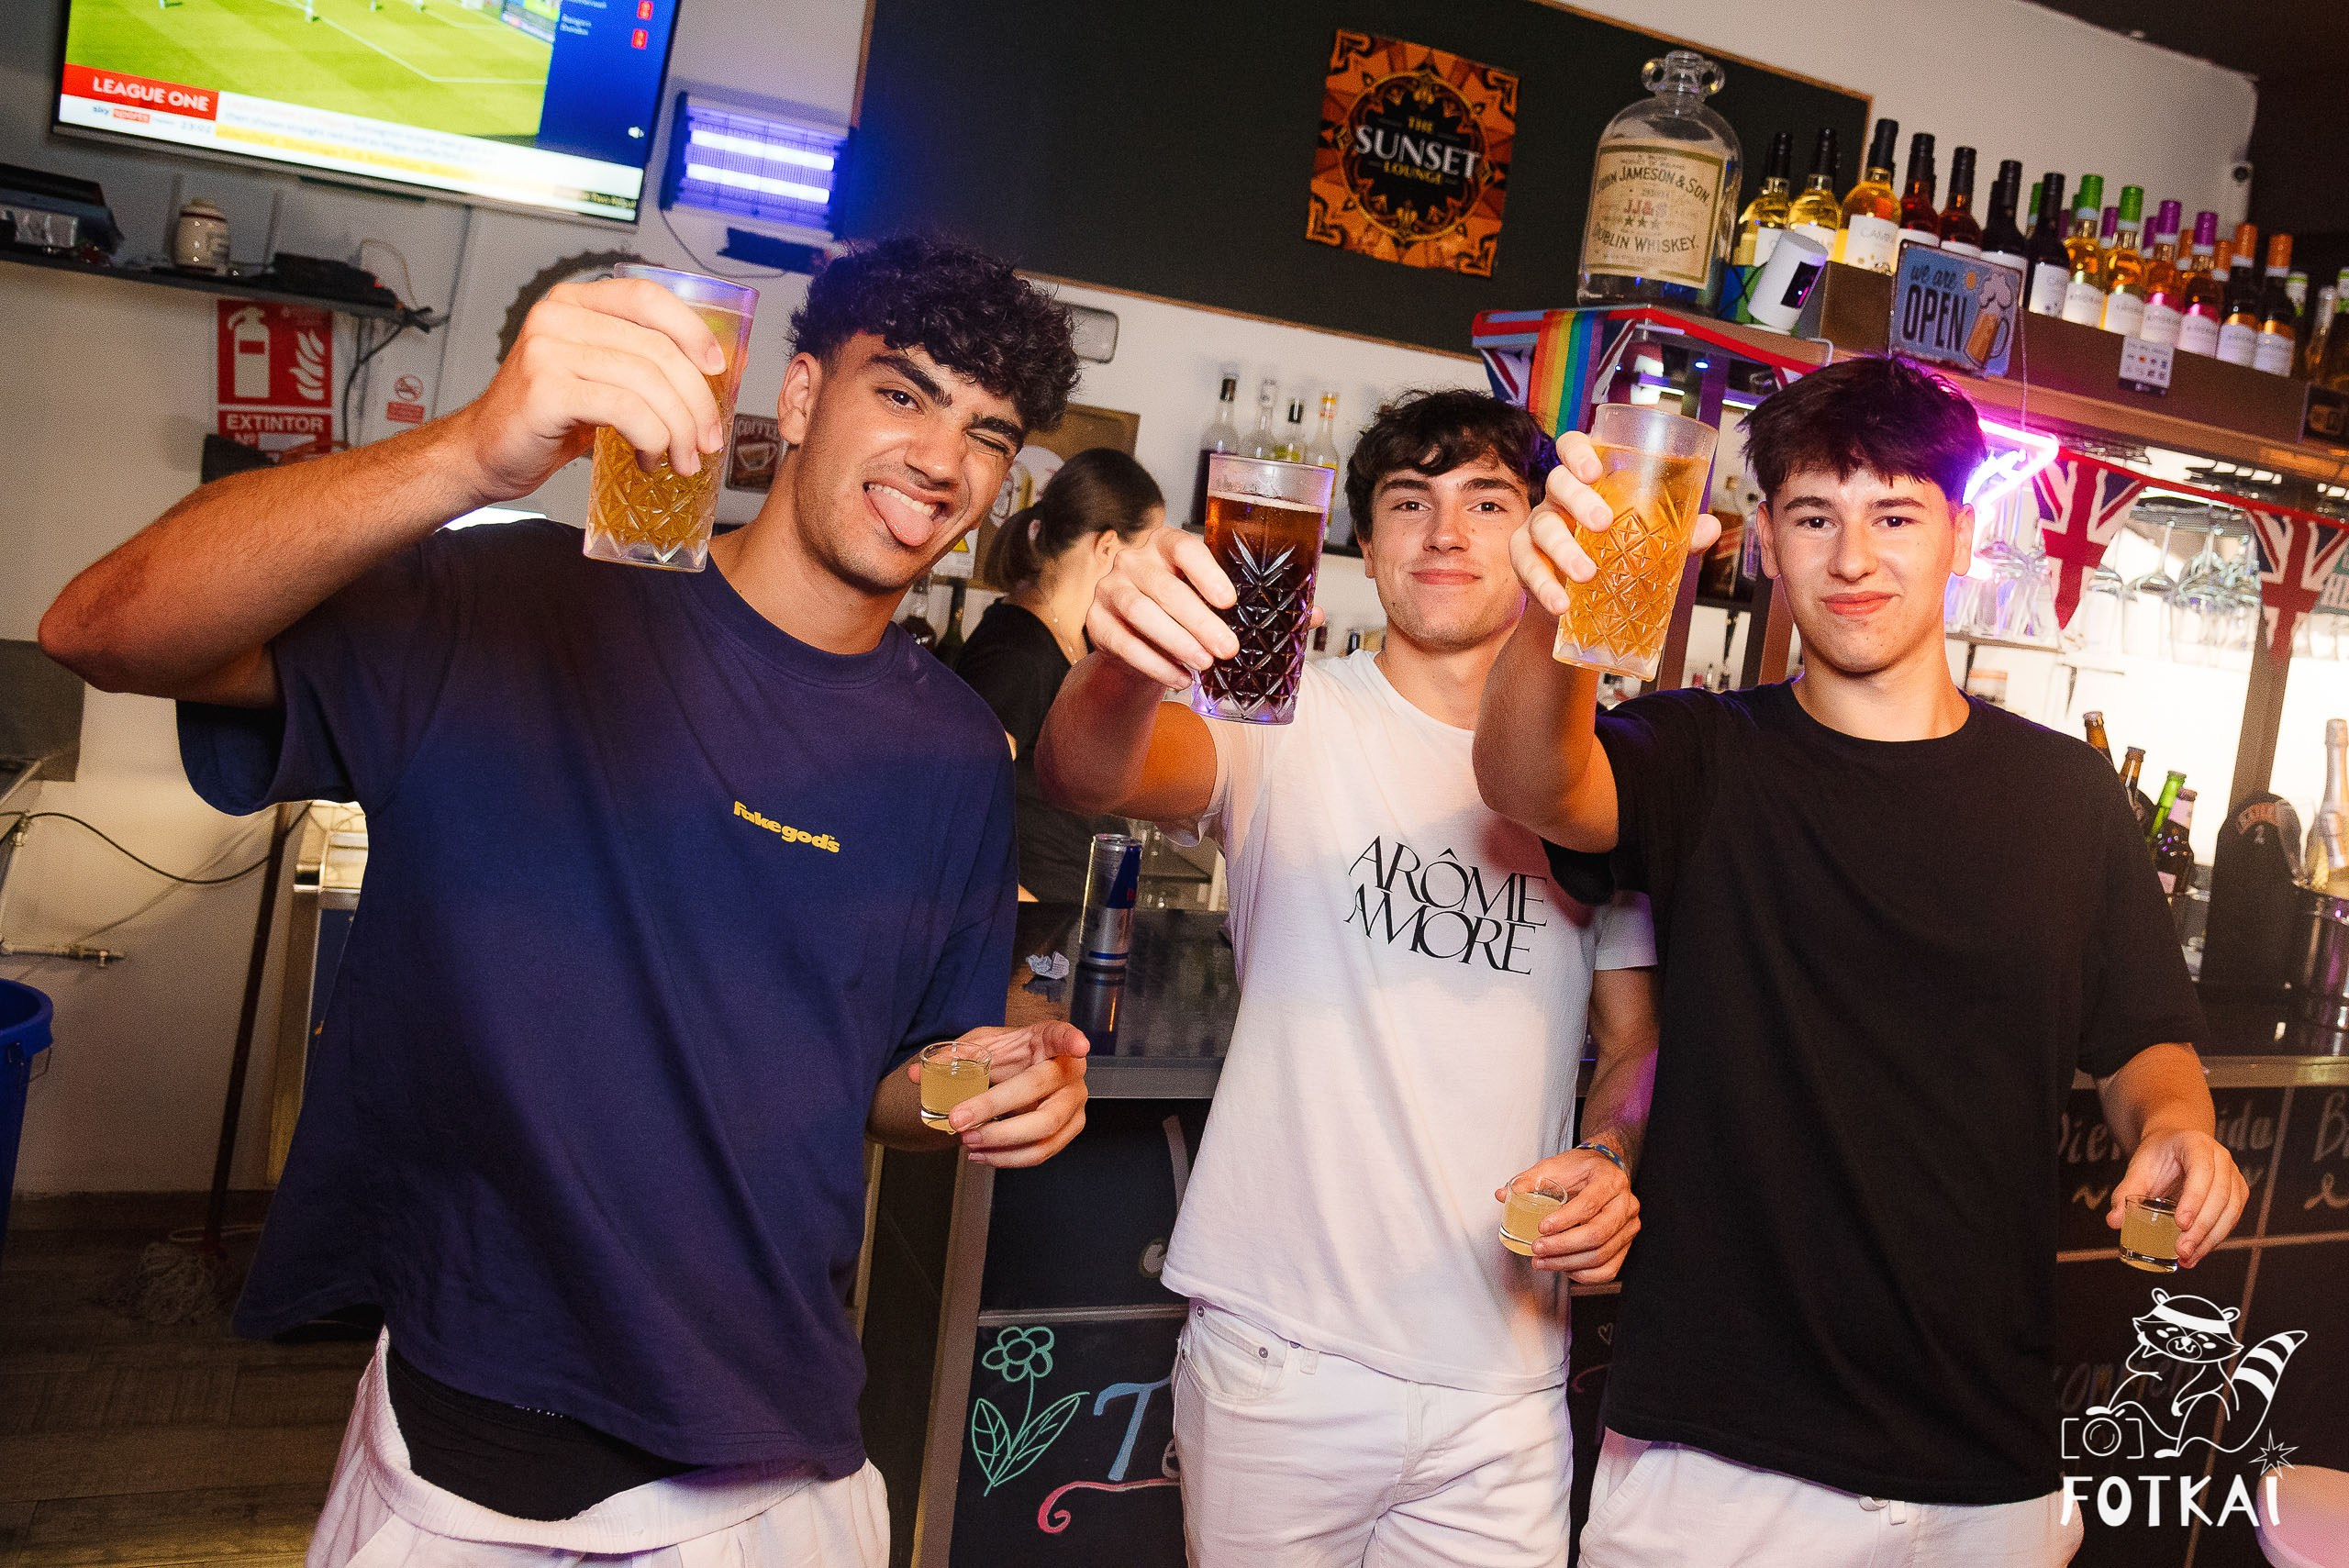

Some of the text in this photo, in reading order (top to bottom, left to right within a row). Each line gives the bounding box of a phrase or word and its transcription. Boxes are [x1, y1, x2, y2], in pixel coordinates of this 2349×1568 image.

[94, 76, 211, 112] LEAGUE ONE
[1408, 116, 1433, 132] THE
[1355, 125, 1482, 179] SUNSET
[1383, 161, 1442, 184] LOUNGE
[1620, 165, 1676, 184] JAMESON
[1675, 175, 1687, 189] &
[1902, 284, 1967, 352] OPEN
[226, 413, 325, 432] EXTINTOR
[1348, 835, 1548, 928] ARÔME
[1342, 883, 1537, 975] AMORE
